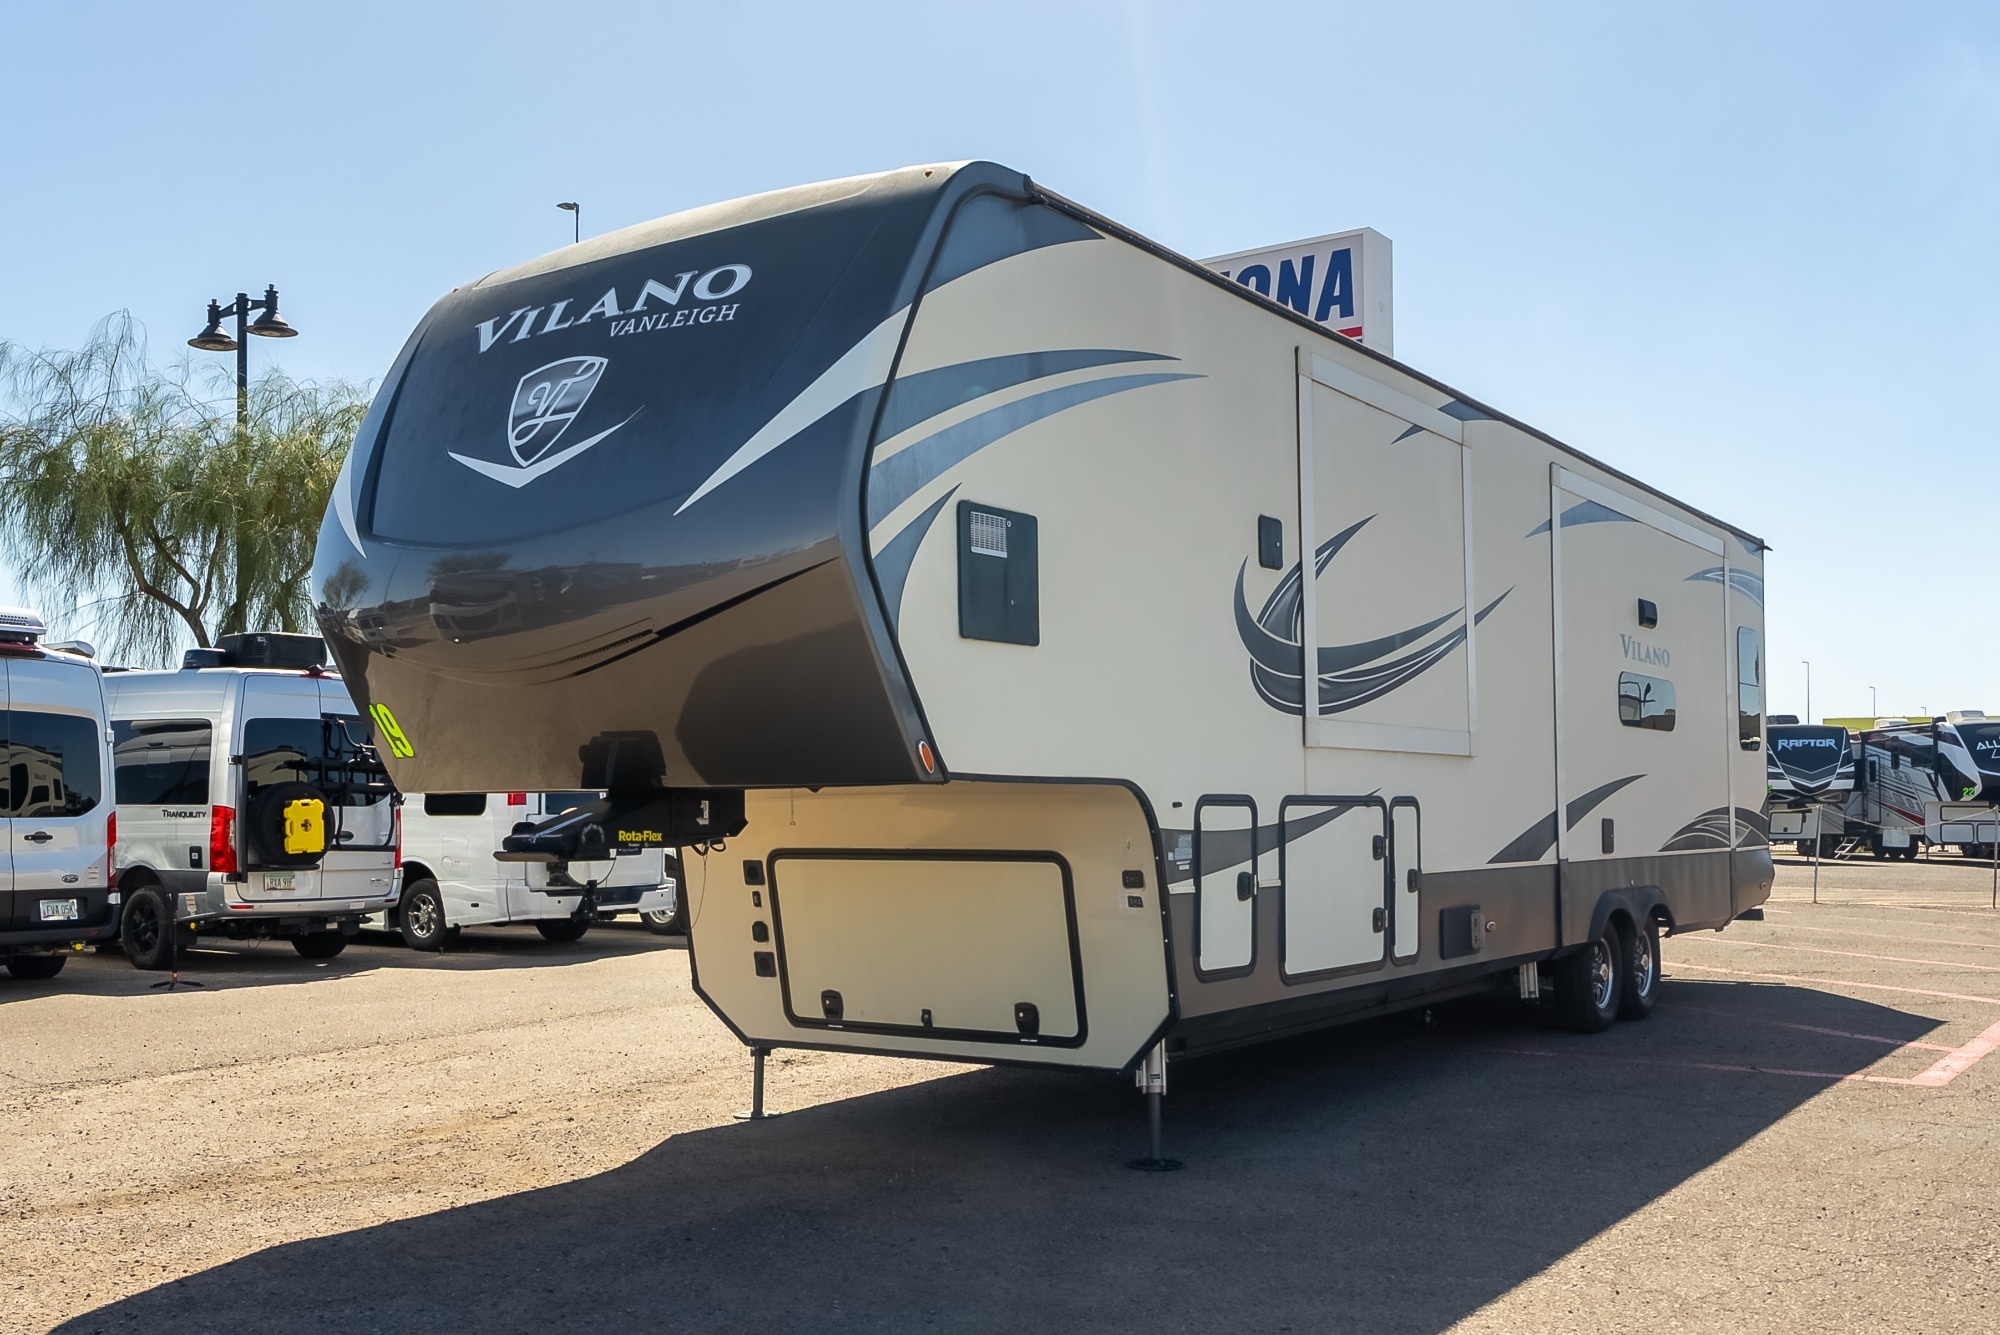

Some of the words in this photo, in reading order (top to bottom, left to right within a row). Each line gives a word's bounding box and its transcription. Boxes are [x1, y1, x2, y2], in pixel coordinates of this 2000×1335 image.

[474, 264, 753, 354] VILANO
[609, 303, 740, 338] VANLEIGH
[1619, 633, 1670, 668] VILANO
[368, 703, 415, 758] 19
[1777, 738, 1839, 752] RAPTOR
[1962, 787, 1975, 797] 22
[161, 809, 207, 819] TRANQUILITY
